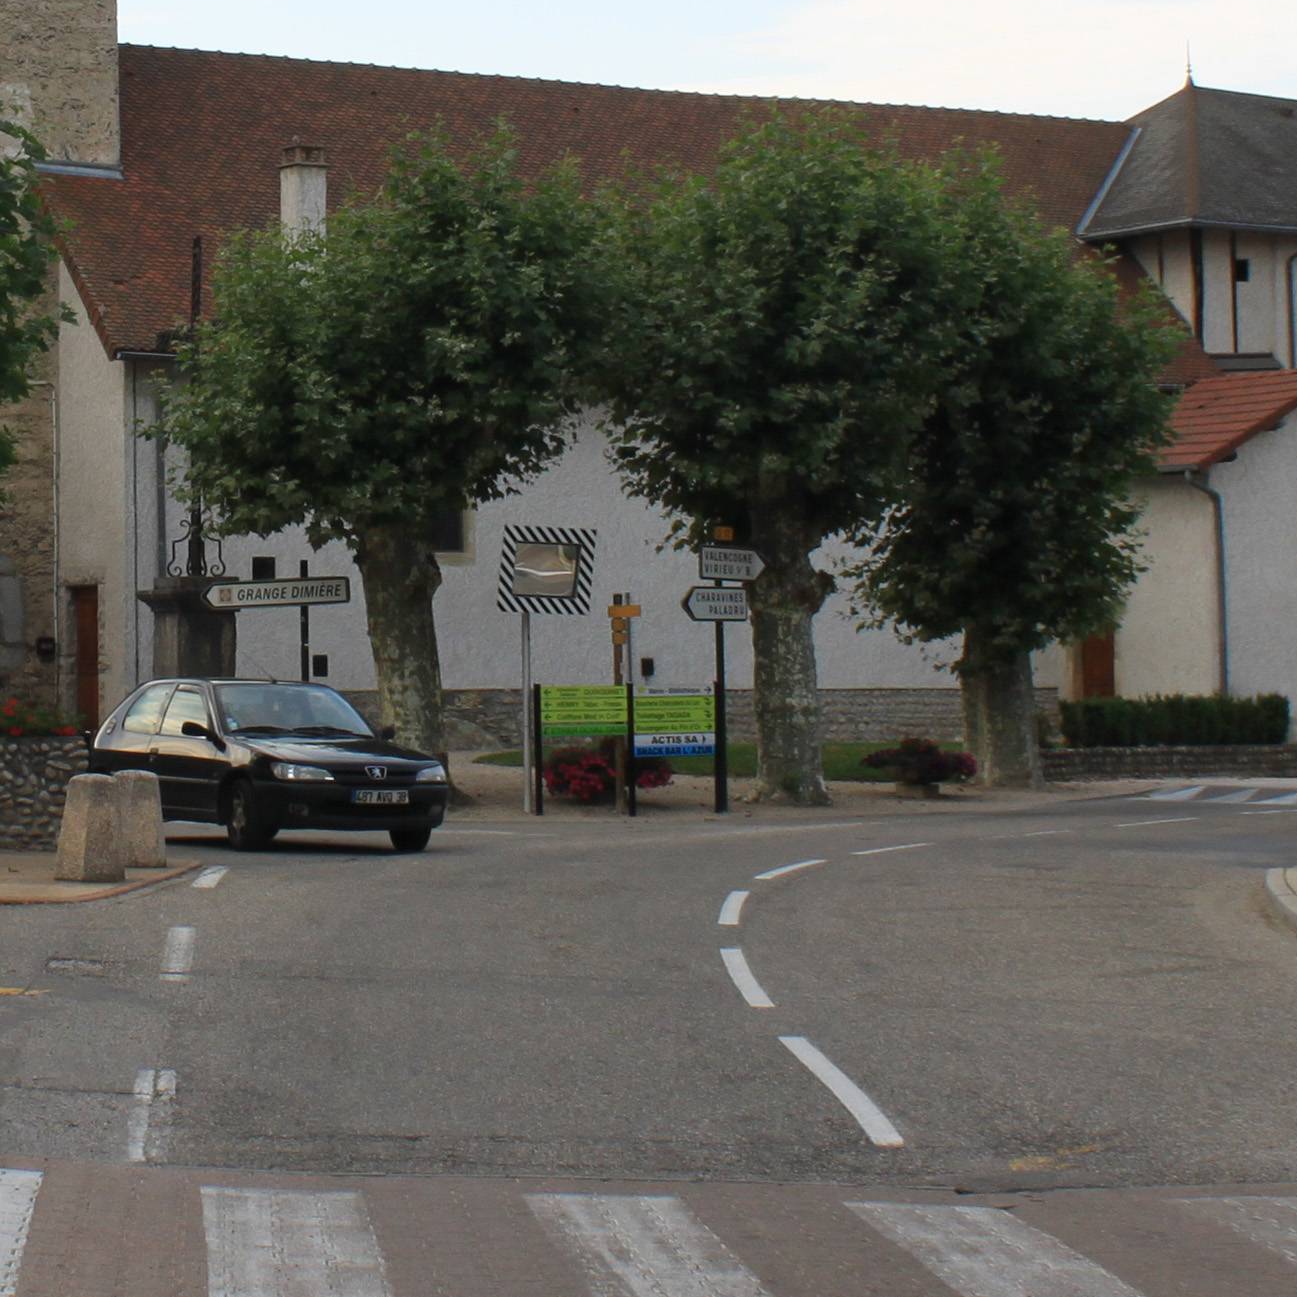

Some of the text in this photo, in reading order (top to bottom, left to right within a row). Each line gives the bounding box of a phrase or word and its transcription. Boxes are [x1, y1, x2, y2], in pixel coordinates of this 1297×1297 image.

[704, 551, 753, 564] VALENCOGNE
[704, 563, 733, 575] VIRIEU
[237, 582, 342, 602] GRANGE DIMIÈRE
[696, 592, 743, 602] CHARAVINES
[709, 605, 745, 616] PALADRU
[651, 735, 698, 745] ACTIS SA
[665, 746, 681, 755] BAR
[396, 791, 407, 801] 38
